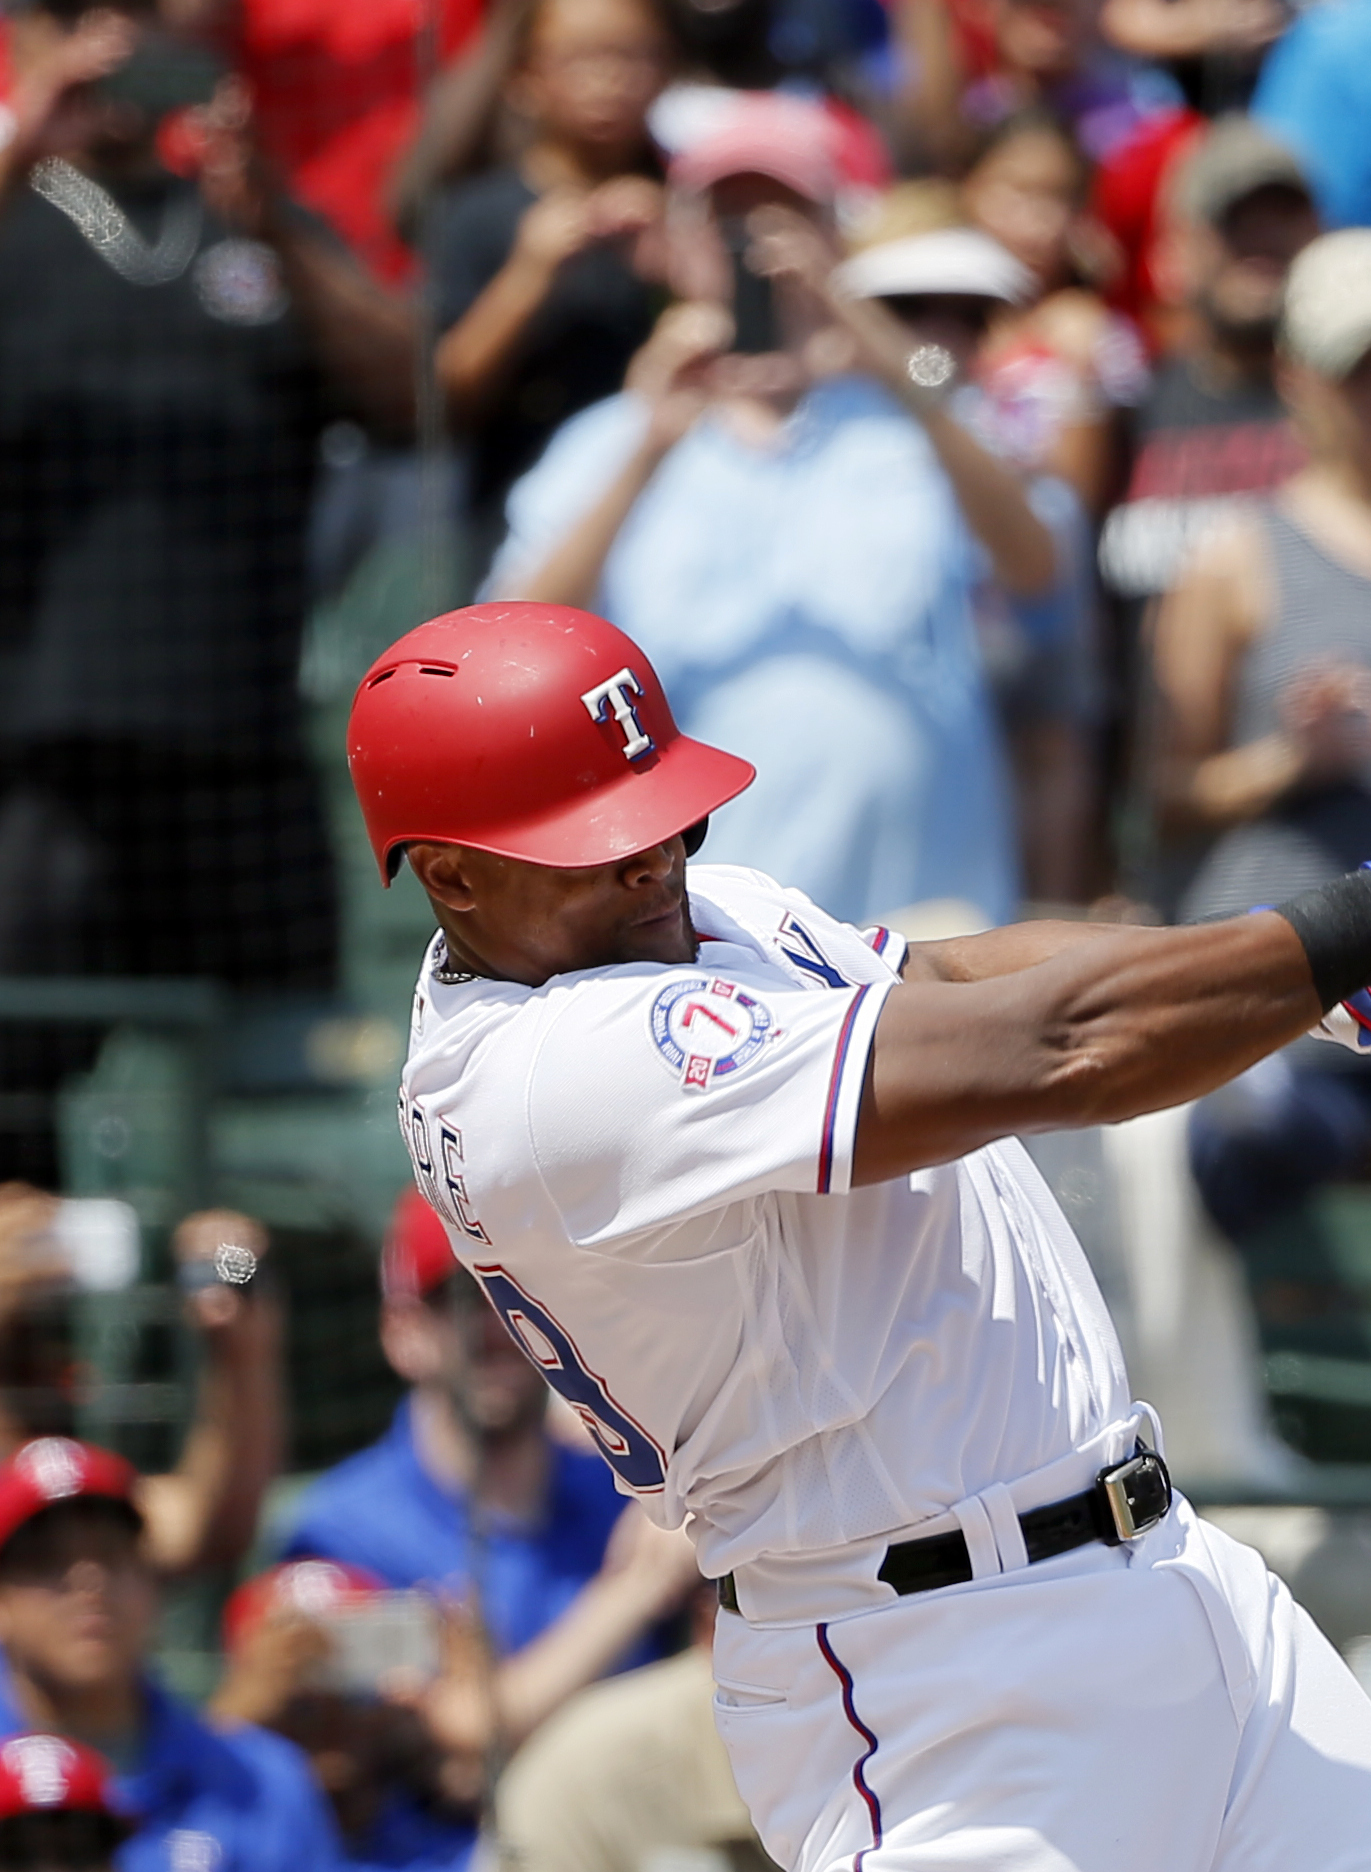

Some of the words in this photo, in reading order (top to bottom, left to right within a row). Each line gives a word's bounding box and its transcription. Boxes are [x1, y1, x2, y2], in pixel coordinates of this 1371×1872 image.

[580, 667, 655, 762] T
[681, 1001, 739, 1041] 7
[688, 1058, 709, 1081] 20
